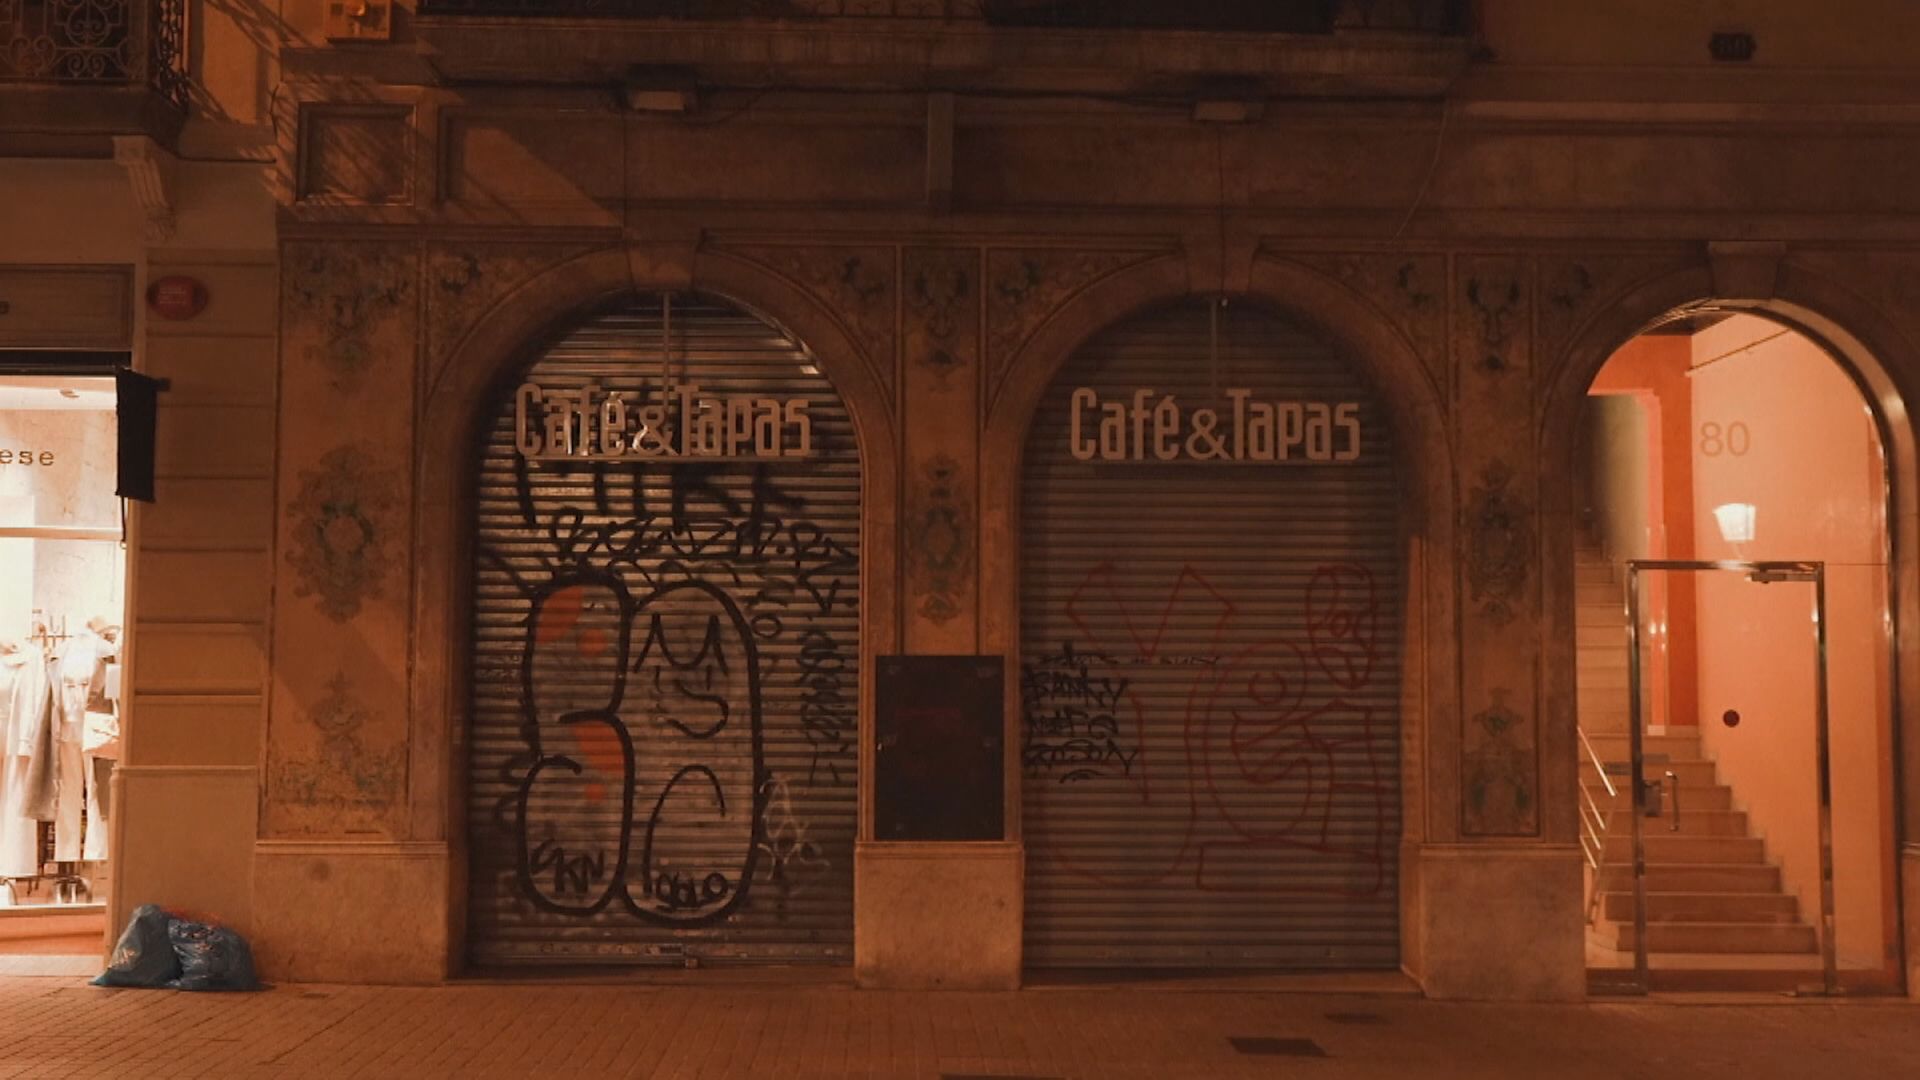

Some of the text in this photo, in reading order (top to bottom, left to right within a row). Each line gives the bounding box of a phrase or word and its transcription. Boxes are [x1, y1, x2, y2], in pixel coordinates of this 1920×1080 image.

[515, 384, 811, 456] Café & Tapas
[1071, 387, 1361, 460] Café & Tapas
[1700, 421, 1750, 457] 80
